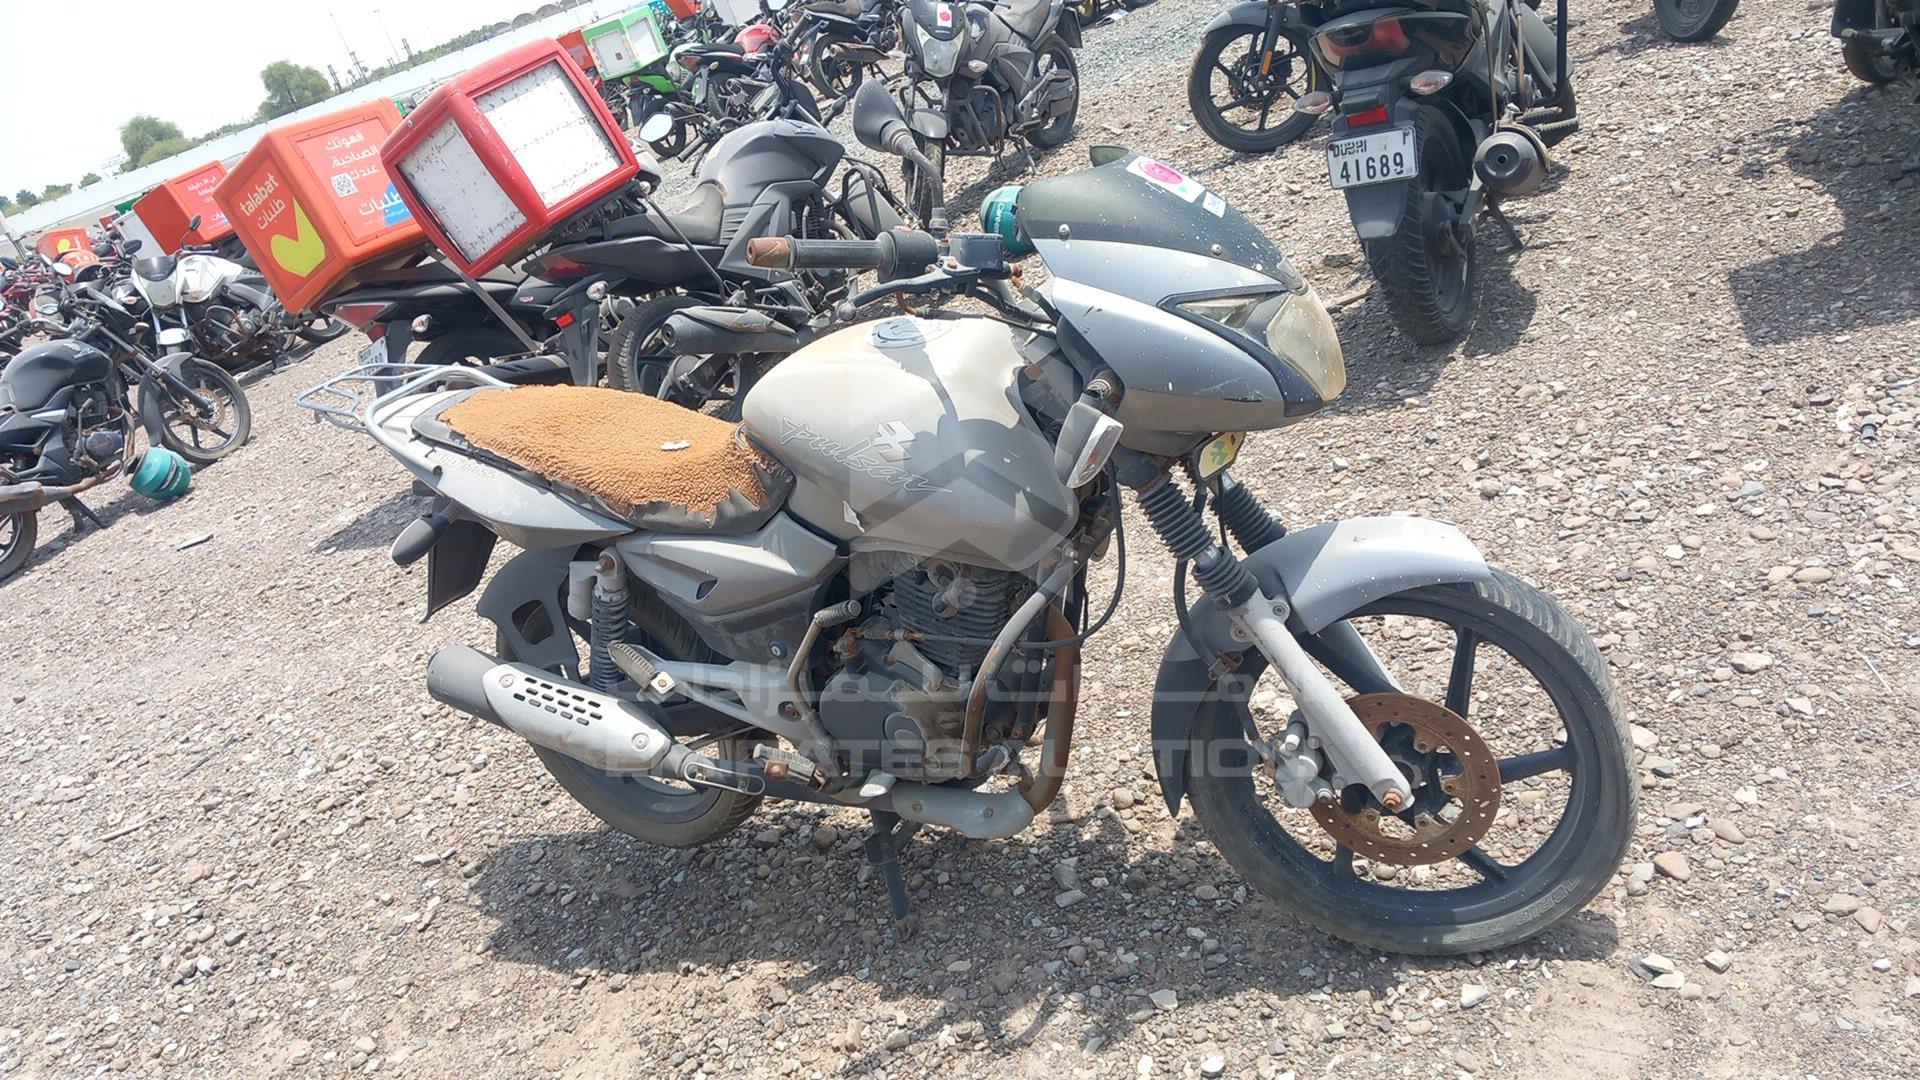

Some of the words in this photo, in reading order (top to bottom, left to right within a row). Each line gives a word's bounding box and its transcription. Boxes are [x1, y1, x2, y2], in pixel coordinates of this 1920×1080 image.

[1340, 152, 1404, 183] 41689
[239, 172, 279, 216] talabat
[257, 199, 286, 230] طلبات
